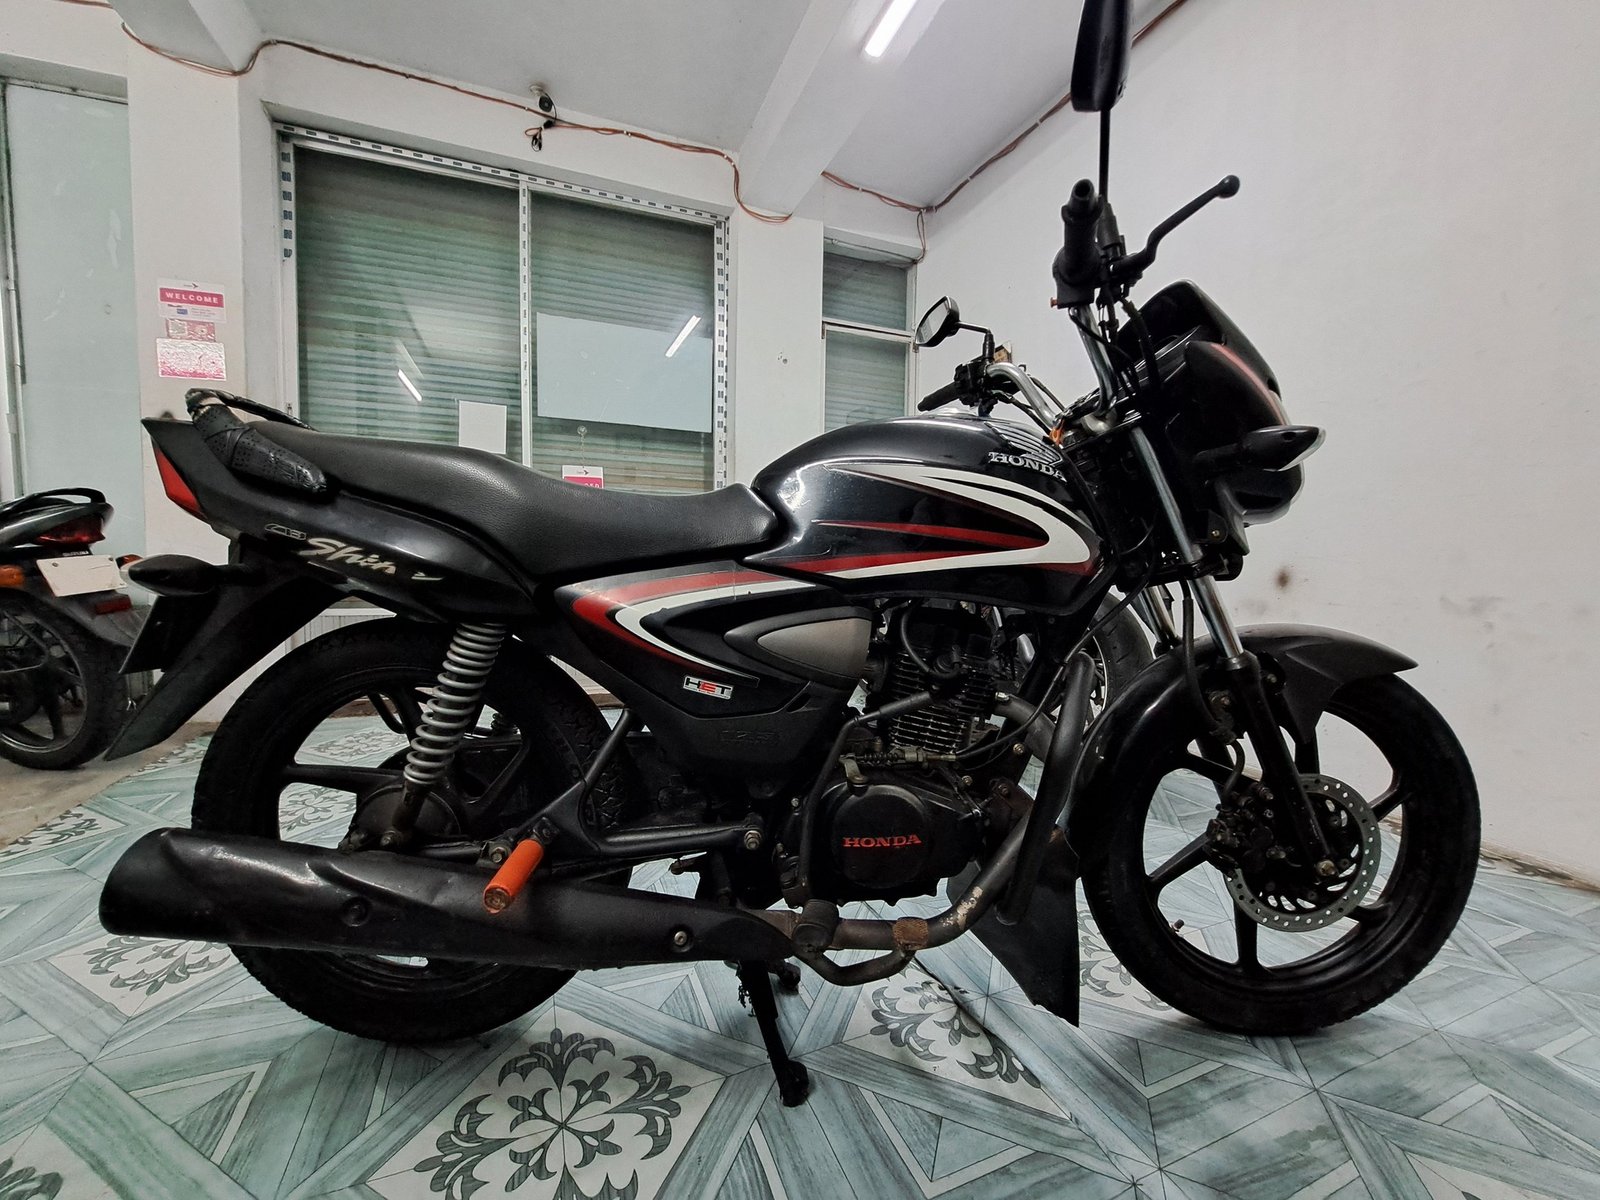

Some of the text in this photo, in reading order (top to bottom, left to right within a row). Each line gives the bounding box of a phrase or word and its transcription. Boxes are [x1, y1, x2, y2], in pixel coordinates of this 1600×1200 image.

[165, 291, 219, 304] WELCOME
[988, 451, 1067, 483] HONDA
[264, 523, 307, 541] CB
[685, 677, 732, 695] HET
[842, 834, 922, 848] HONDA
